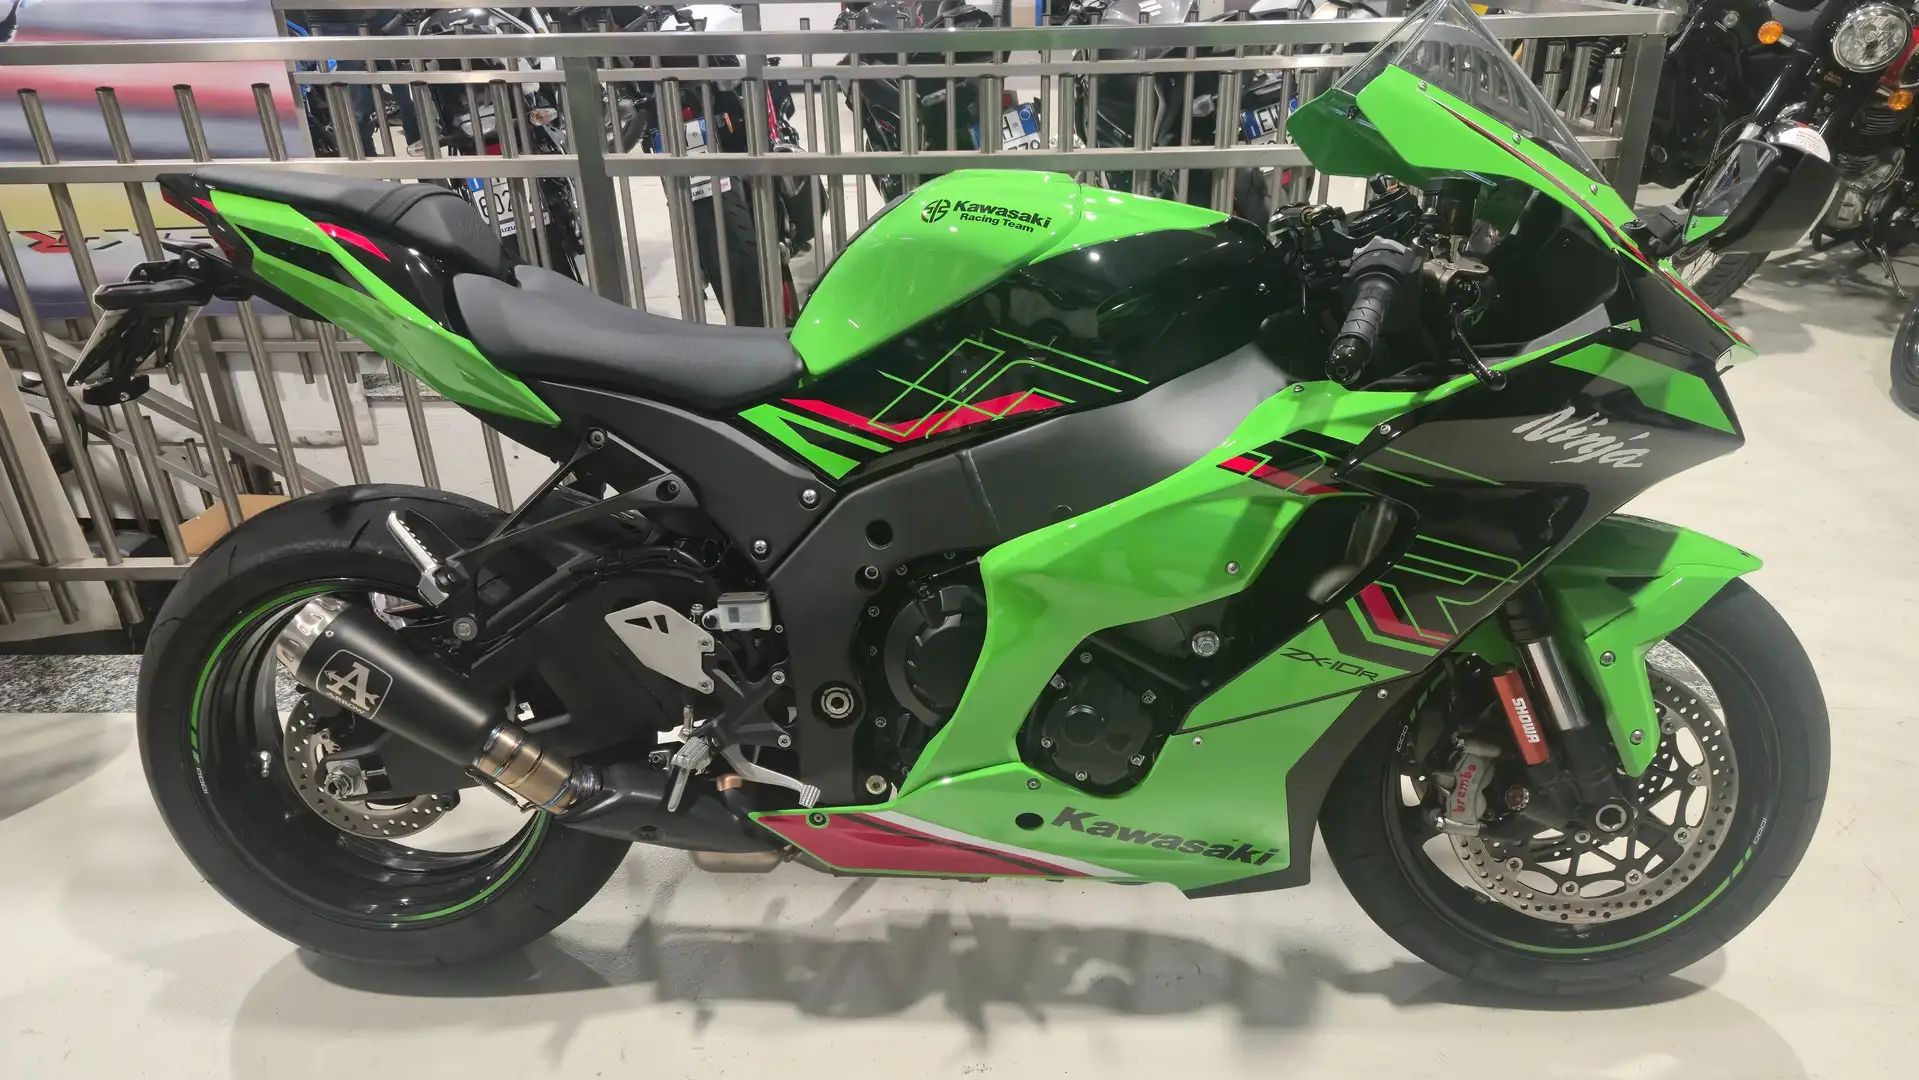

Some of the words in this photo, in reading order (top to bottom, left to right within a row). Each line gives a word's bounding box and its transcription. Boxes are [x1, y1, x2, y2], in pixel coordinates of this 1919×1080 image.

[952, 199, 1052, 229] Kawasaki
[959, 212, 1000, 226] Racing
[1002, 218, 1034, 233] Team
[1511, 406, 1651, 468] Ninja
[1279, 647, 1380, 682] ZX-10R
[325, 691, 365, 714] ARROW
[1511, 697, 1541, 744] SHOWA
[1396, 724, 1409, 753] 1000
[1453, 763, 1477, 813] brembo
[1051, 806, 1280, 866] Kawasaki
